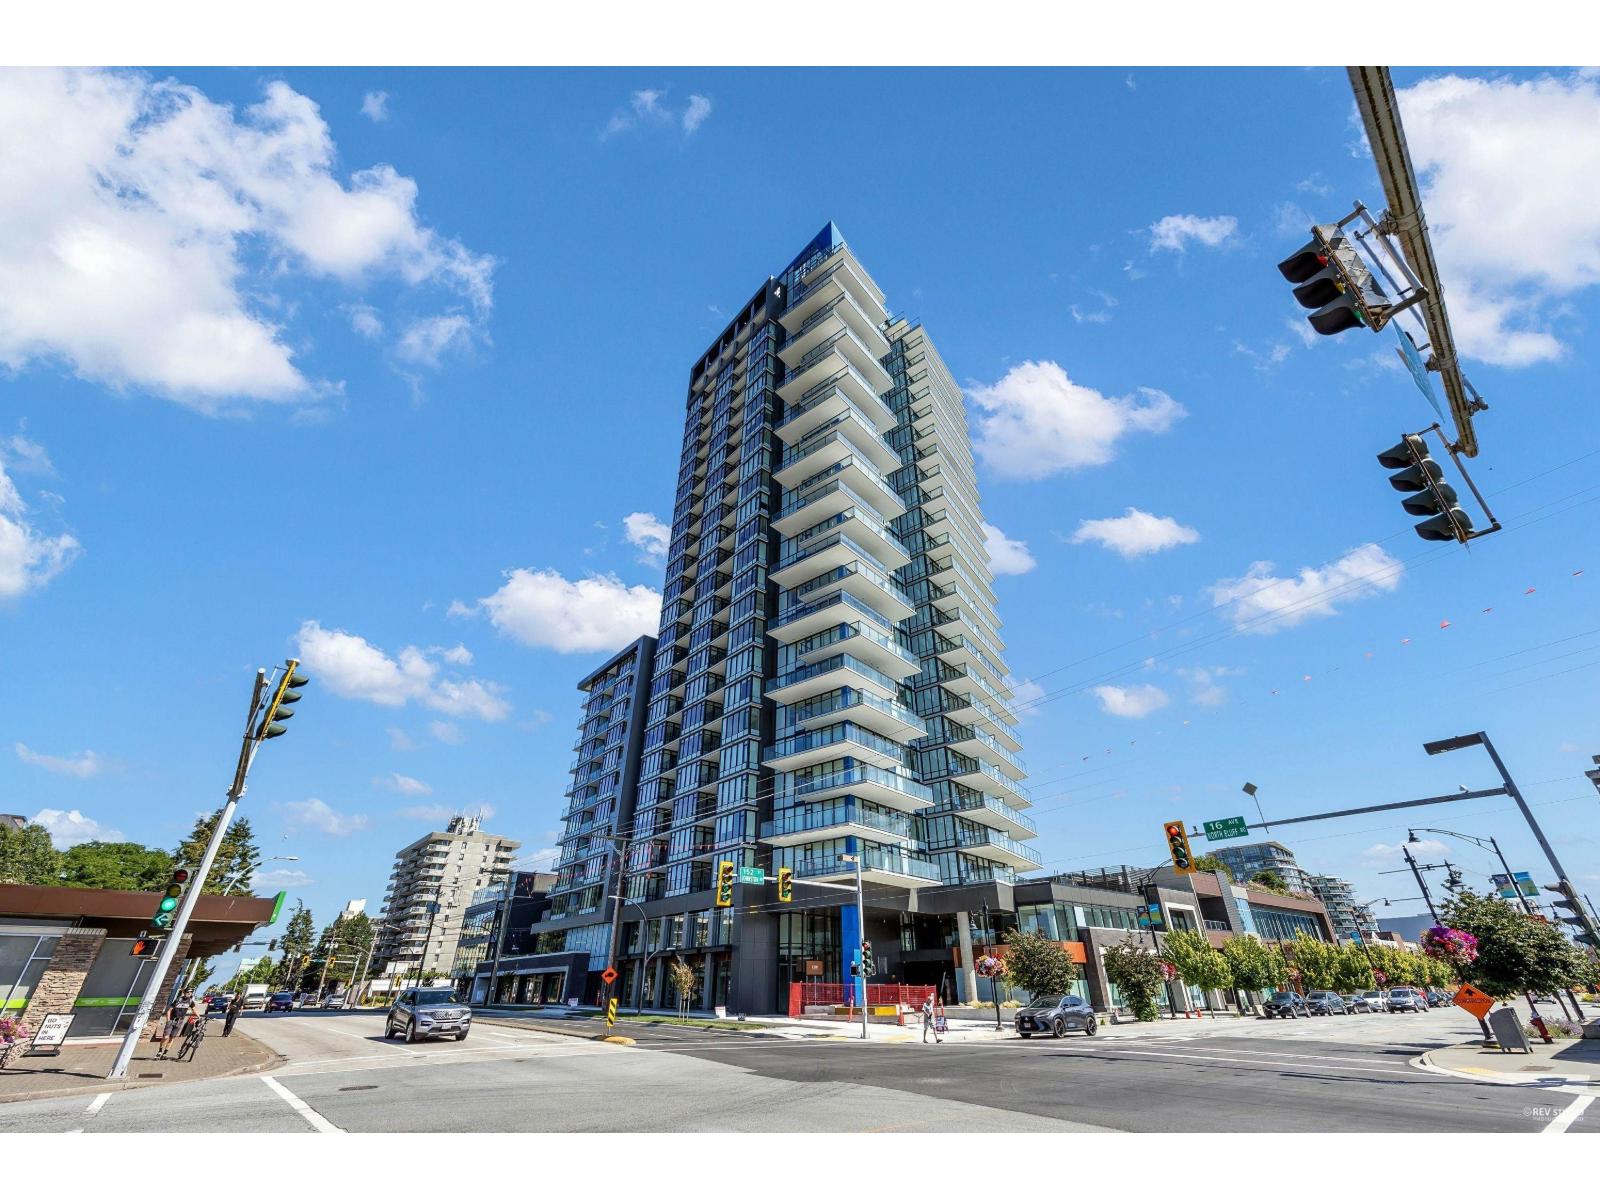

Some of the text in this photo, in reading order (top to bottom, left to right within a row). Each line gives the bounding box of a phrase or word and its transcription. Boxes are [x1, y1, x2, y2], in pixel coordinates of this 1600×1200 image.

[1209, 821, 1223, 830] 16
[1206, 830, 1224, 840] NORTH
[1224, 828, 1238, 838] BLUFF
